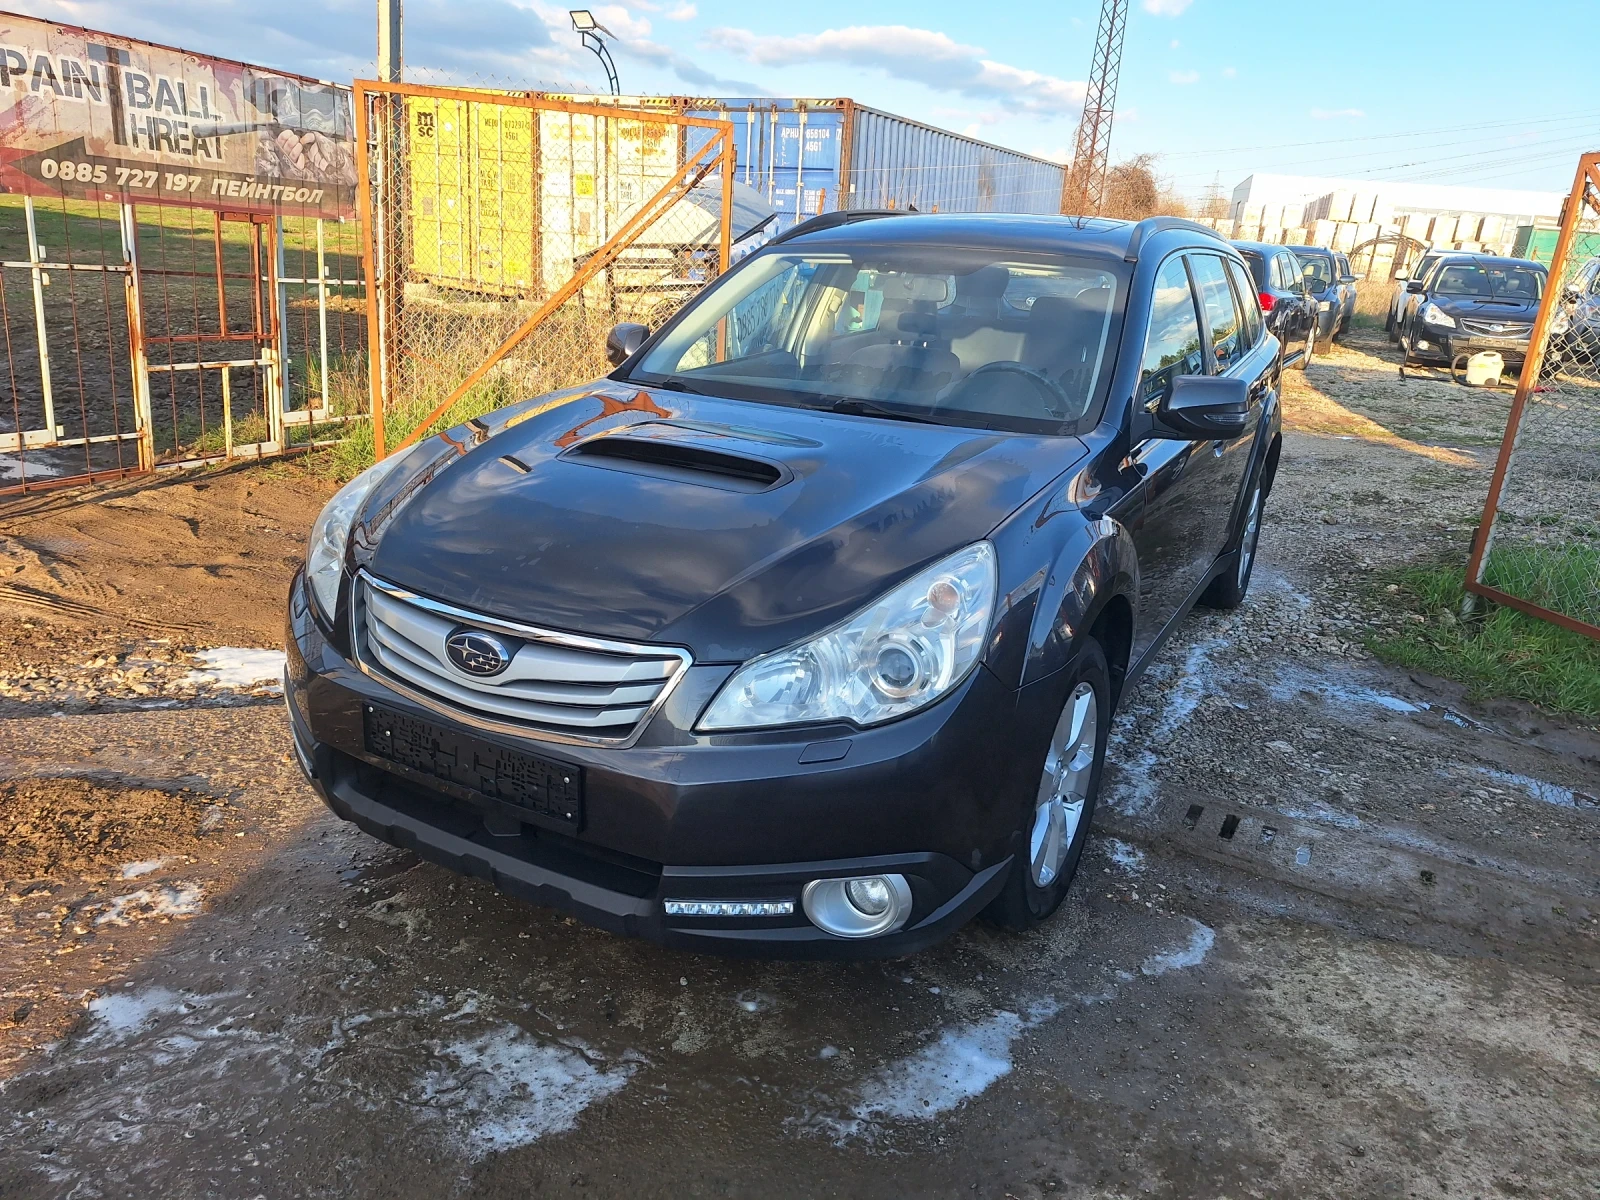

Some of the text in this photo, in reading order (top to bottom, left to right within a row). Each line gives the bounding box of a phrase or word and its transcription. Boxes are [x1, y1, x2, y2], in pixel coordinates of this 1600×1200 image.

[781, 127, 799, 138] APHU
[805, 141, 822, 152] 45G1
[40, 158, 324, 204] 0885 727 197 ПЕЙНТБОЛ
